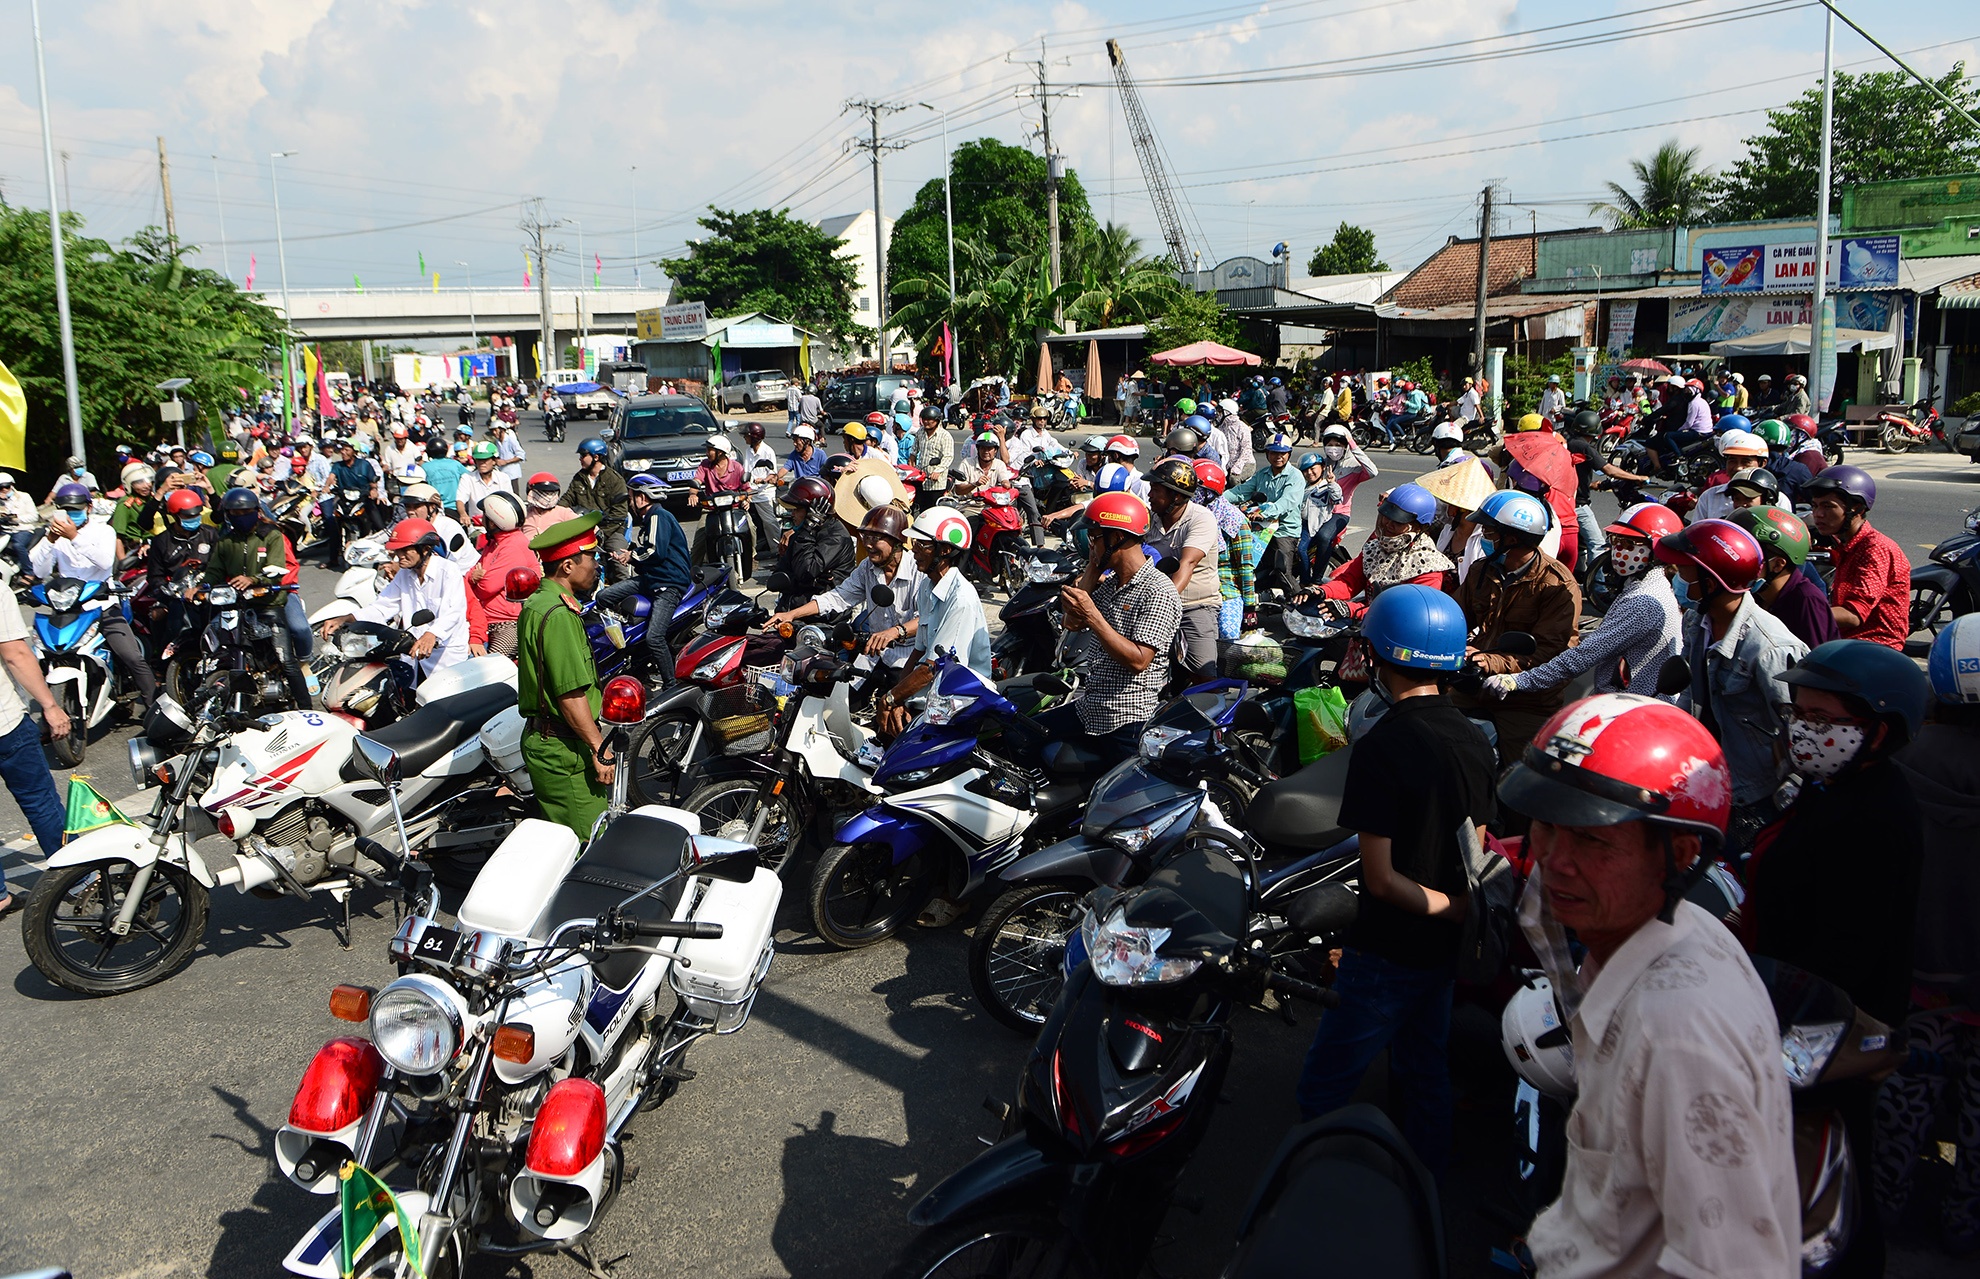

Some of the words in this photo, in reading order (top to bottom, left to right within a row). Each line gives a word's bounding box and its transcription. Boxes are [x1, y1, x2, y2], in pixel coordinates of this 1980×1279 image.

[1775, 262, 1798, 278] LAN
[664, 314, 682, 326] TRUNG
[698, 313, 703, 323] 1
[1767, 310, 1793, 325] LAN
[1099, 511, 1132, 524] CASUMINA
[1412, 650, 1455, 661] Sacombank
[1960, 659, 1978, 672] 3G
[269, 742, 300, 759] HONDA
[423, 937, 443, 952] 81
[603, 993, 634, 1042] POLICE
[1124, 1019, 1163, 1044] HONDA
